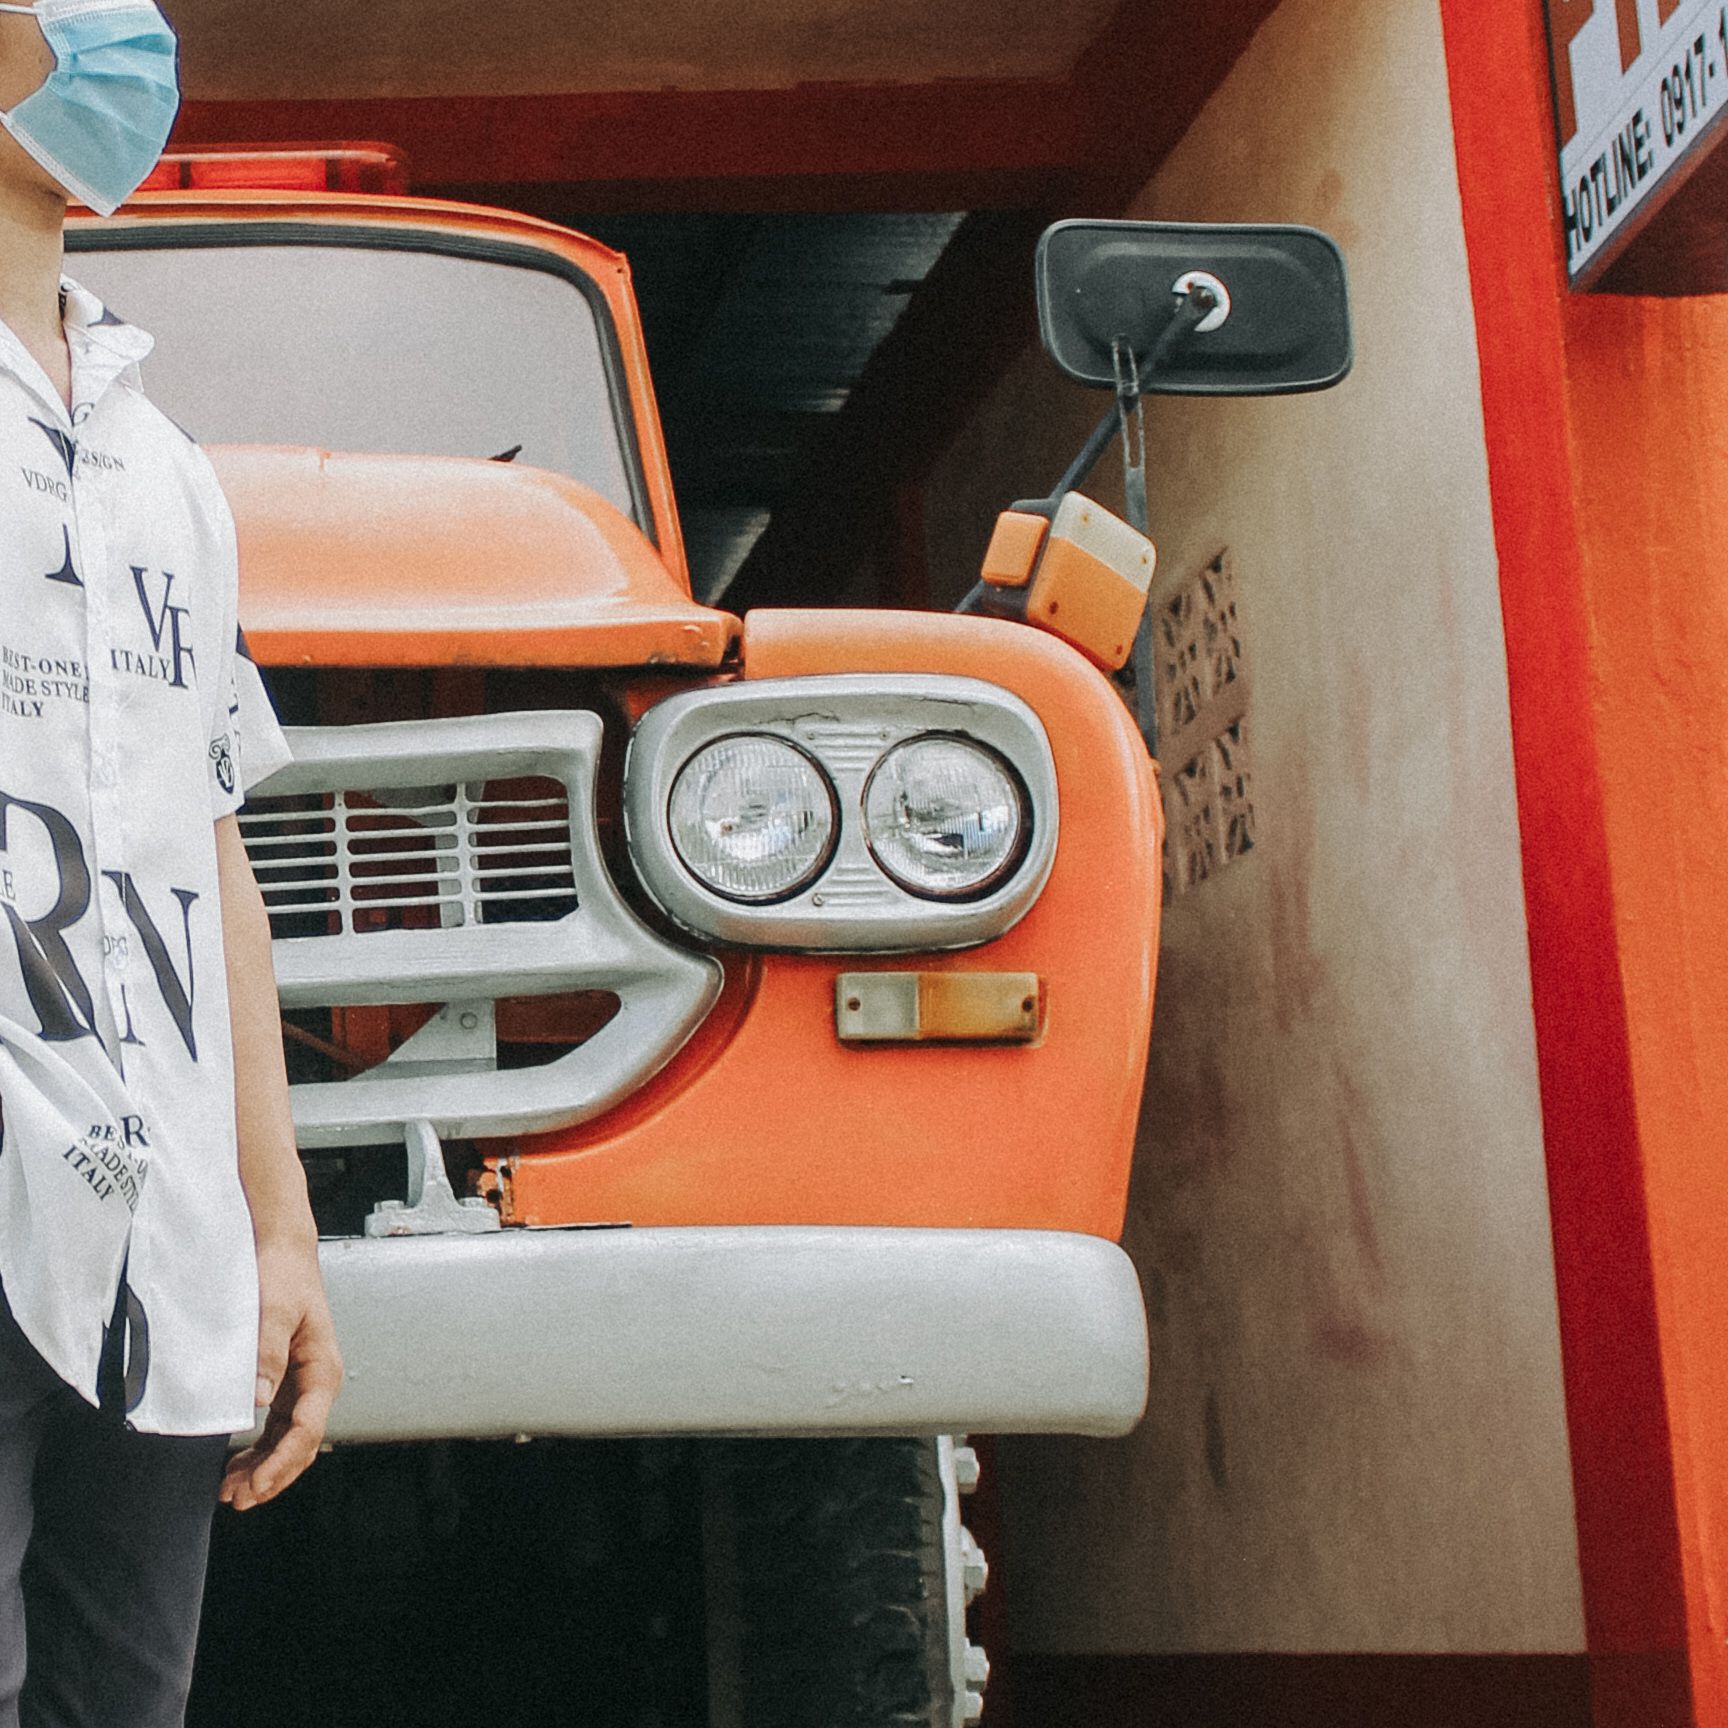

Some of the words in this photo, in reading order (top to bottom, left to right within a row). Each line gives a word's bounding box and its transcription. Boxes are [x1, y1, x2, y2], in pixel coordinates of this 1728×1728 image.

[1563, 107, 1655, 254] HOTLINE:
[2, 644, 82, 680] BEST-ONE
[110, 648, 172, 681] ITALY
[2, 669, 38, 696] MADE
[41, 680, 90, 704] STYLE
[1, 692, 45, 718] ITALY
[62, 1144, 115, 1202] ITALY
